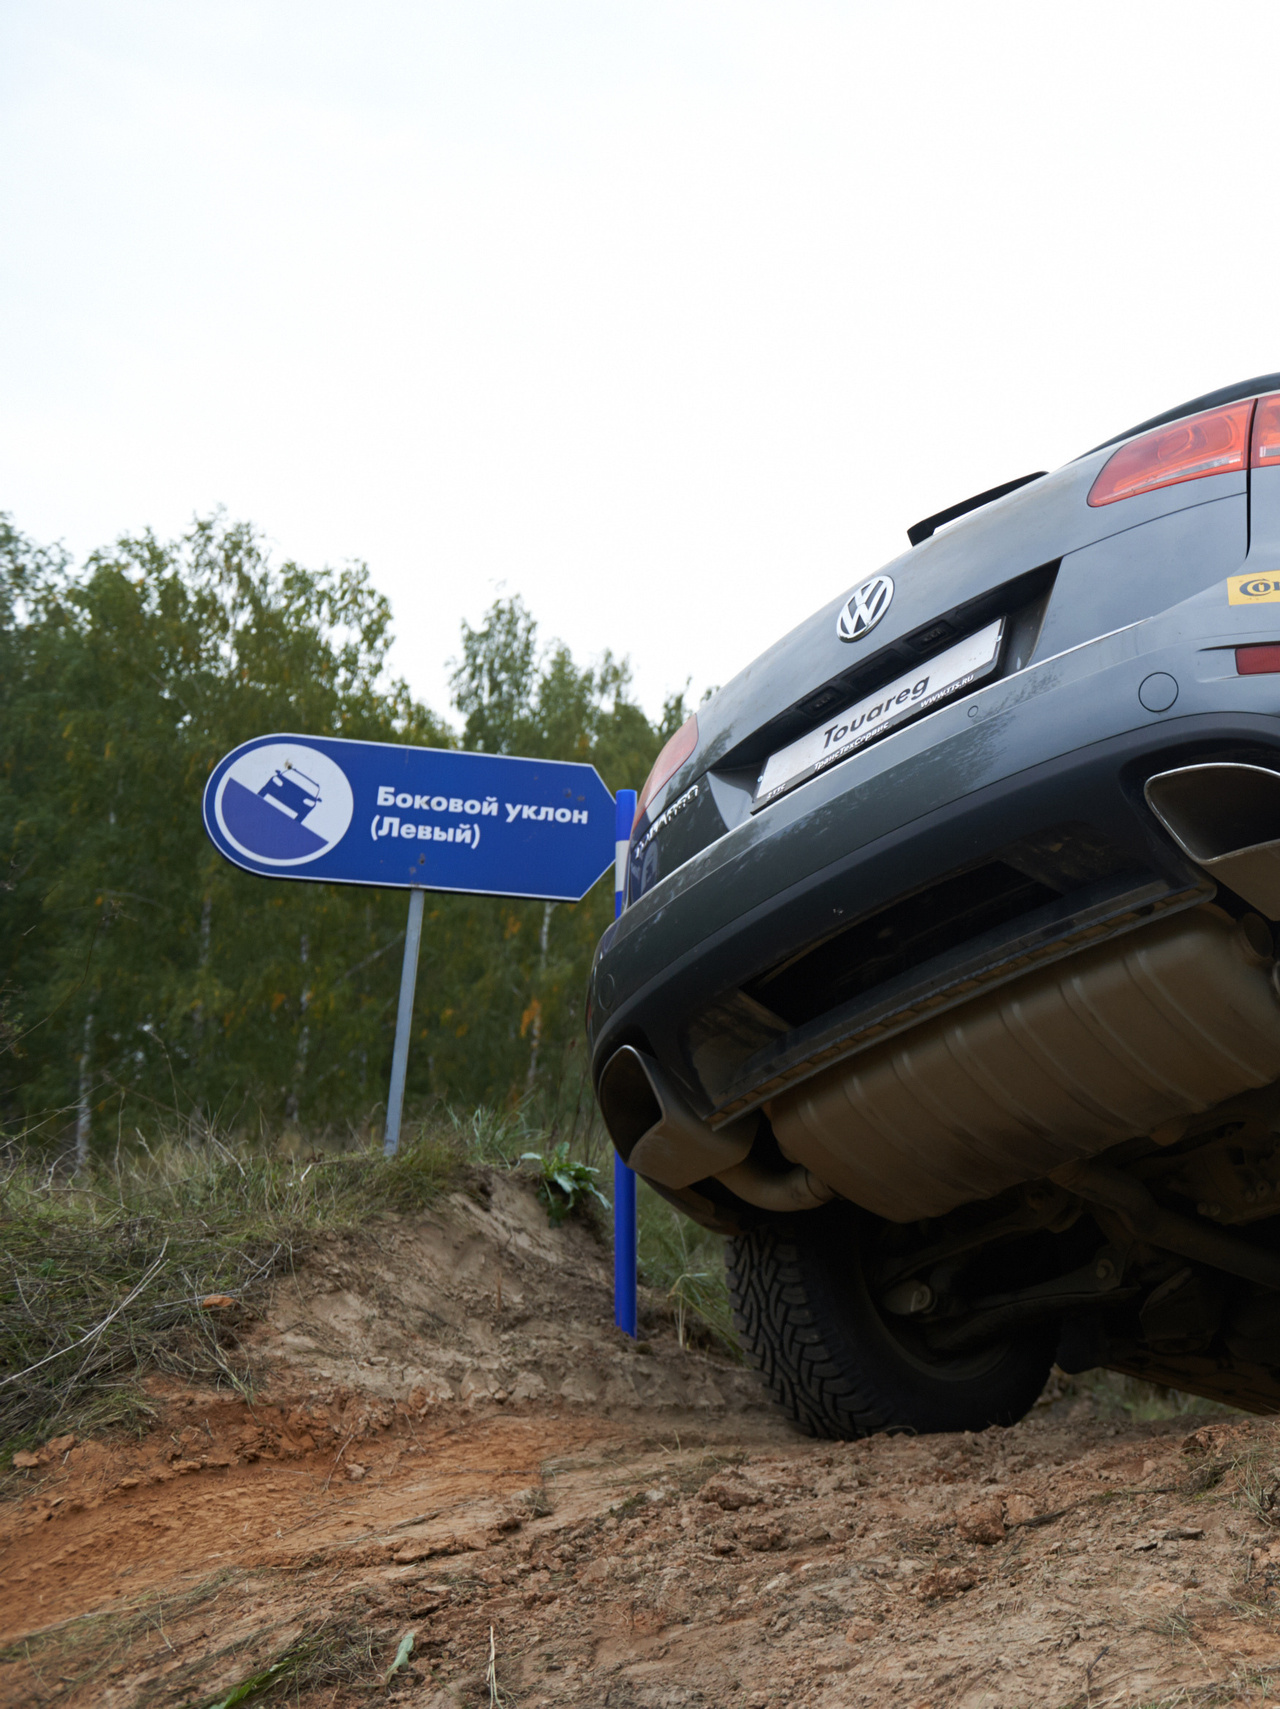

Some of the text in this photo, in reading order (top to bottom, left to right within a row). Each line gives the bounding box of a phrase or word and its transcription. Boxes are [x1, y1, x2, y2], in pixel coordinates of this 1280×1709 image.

[823, 675, 930, 749] Touareg
[376, 785, 589, 825] Боковой уклон
[370, 814, 481, 850] (Левый)
